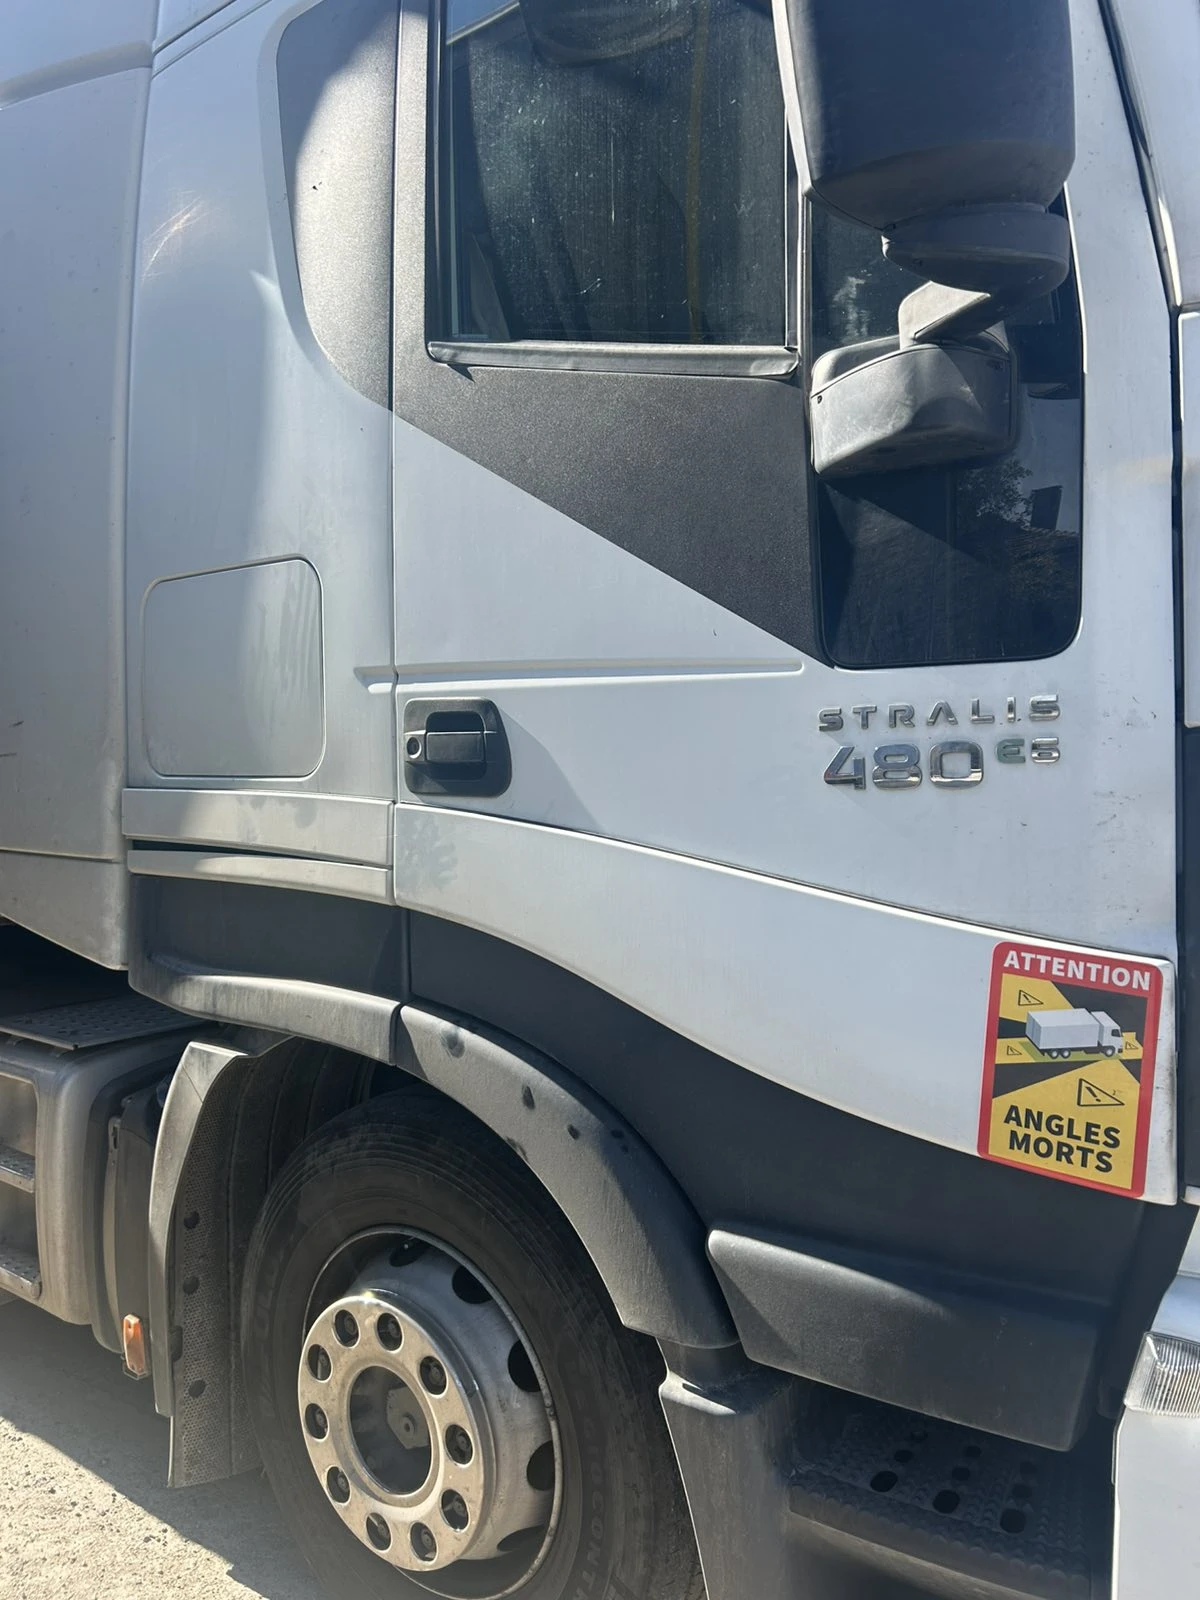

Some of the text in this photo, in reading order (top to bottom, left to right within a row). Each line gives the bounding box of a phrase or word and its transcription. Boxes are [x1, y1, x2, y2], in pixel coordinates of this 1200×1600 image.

[818, 694, 1061, 732] STRALIS
[823, 740, 985, 790] 480
[1003, 950, 1151, 991] ATTENTION
[1003, 1104, 1121, 1149] ANGLES
[1008, 1129, 1113, 1174] MORTS
